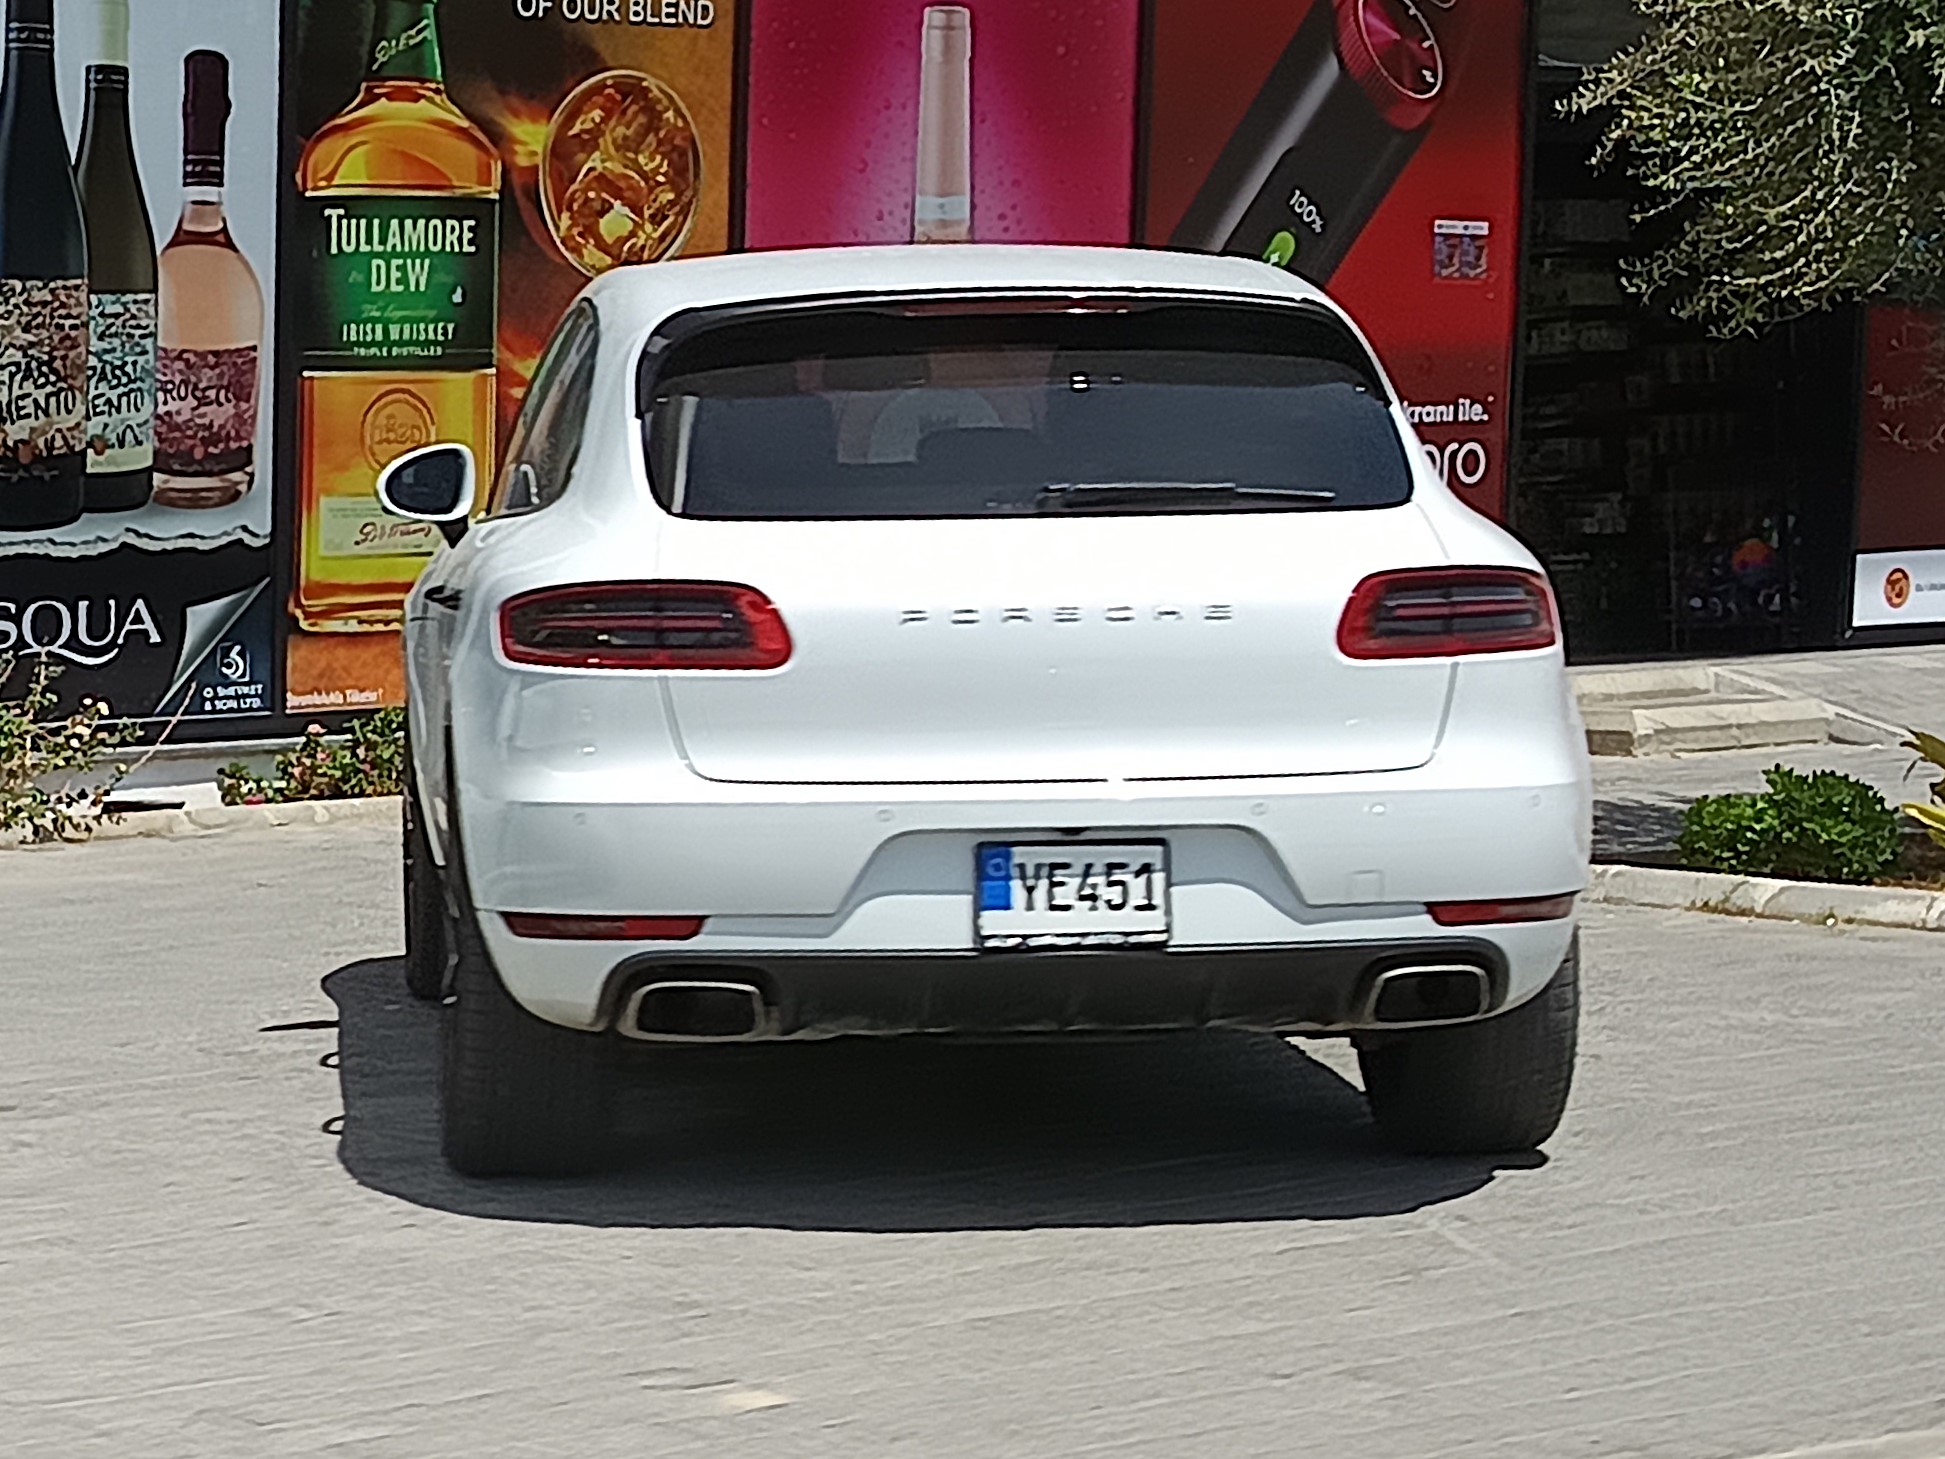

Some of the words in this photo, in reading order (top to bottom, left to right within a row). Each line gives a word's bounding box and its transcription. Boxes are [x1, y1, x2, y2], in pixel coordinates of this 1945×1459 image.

[516, 0, 552, 18] OF
[562, 0, 621, 21] OUR
[628, 0, 714, 26] BLEND
[324, 208, 477, 255] TULLAMORE
[370, 258, 431, 293] DEW
[342, 323, 384, 342] IRISH
[388, 322, 455, 341] WHISKEY
[899, 604, 1234, 625] PORSCHE
